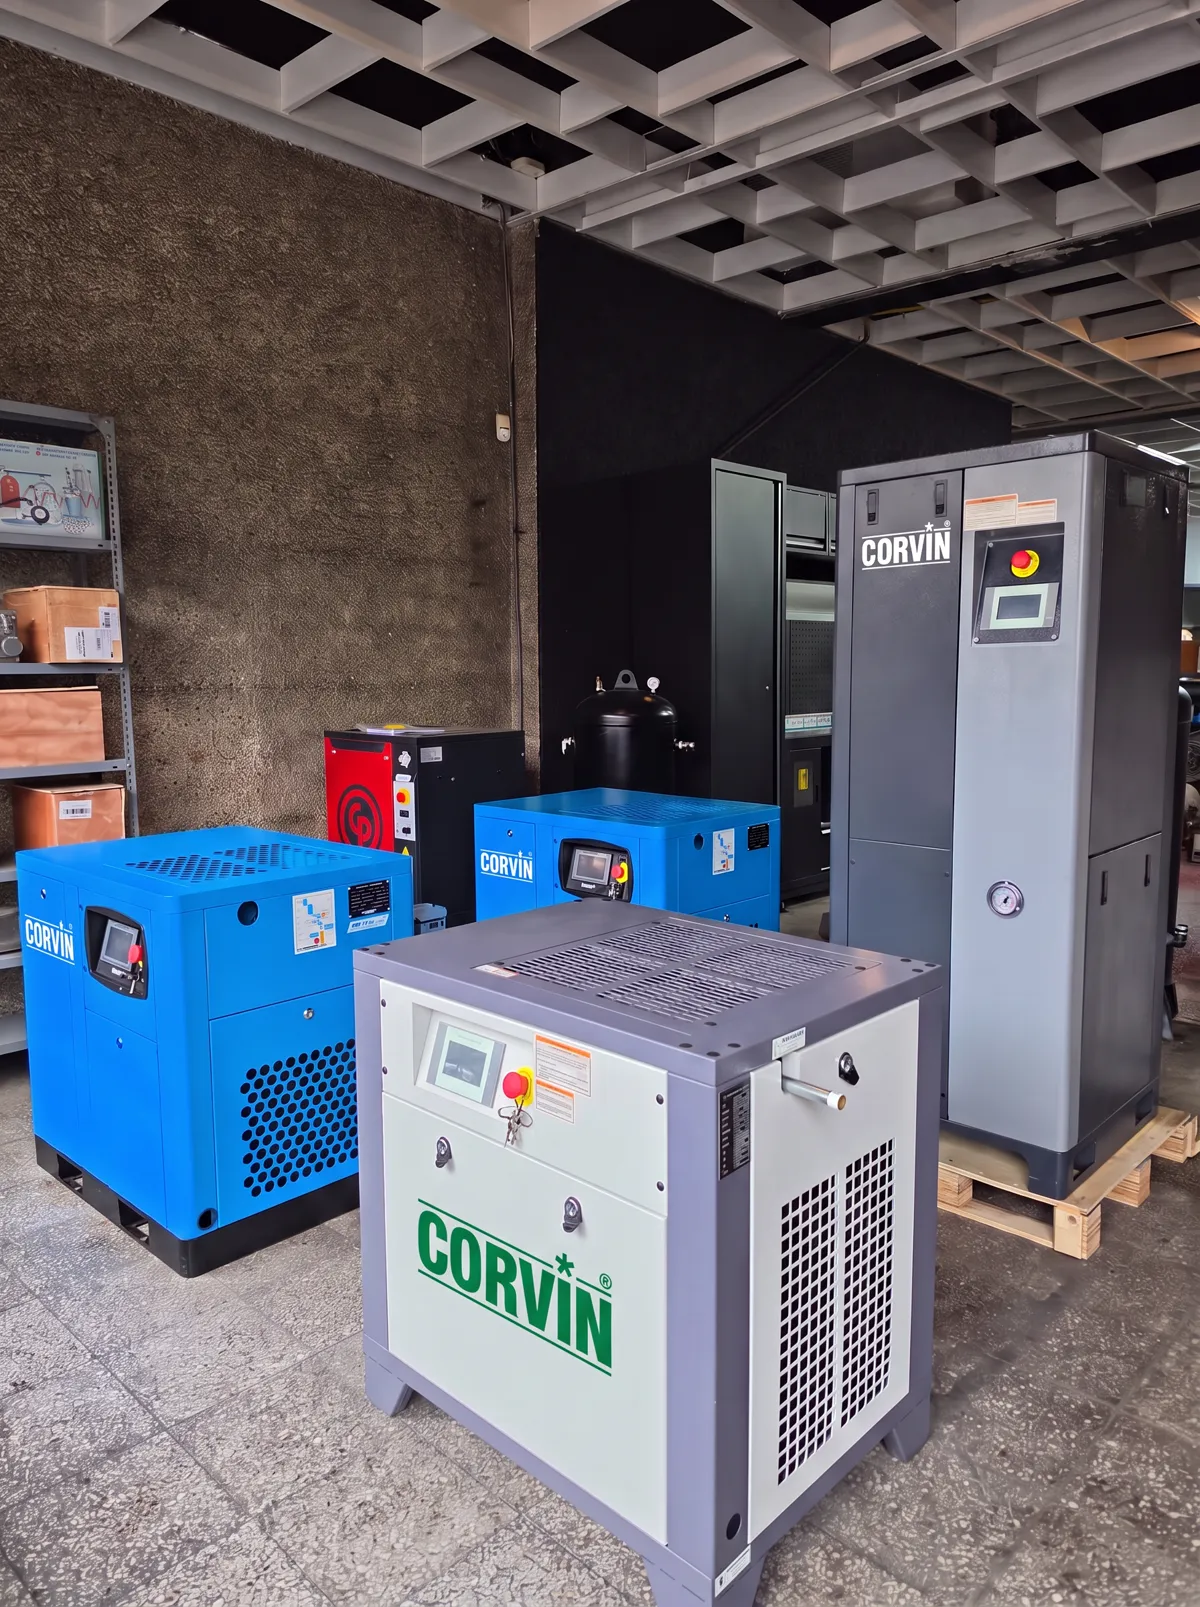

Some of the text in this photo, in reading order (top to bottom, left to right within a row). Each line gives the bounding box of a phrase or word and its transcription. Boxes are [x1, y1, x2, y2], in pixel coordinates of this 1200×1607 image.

[862, 522, 951, 567] CORVIN
[480, 850, 533, 881] CORVIN
[25, 918, 75, 961] CORVIN
[418, 1210, 612, 1369] CORVIN
